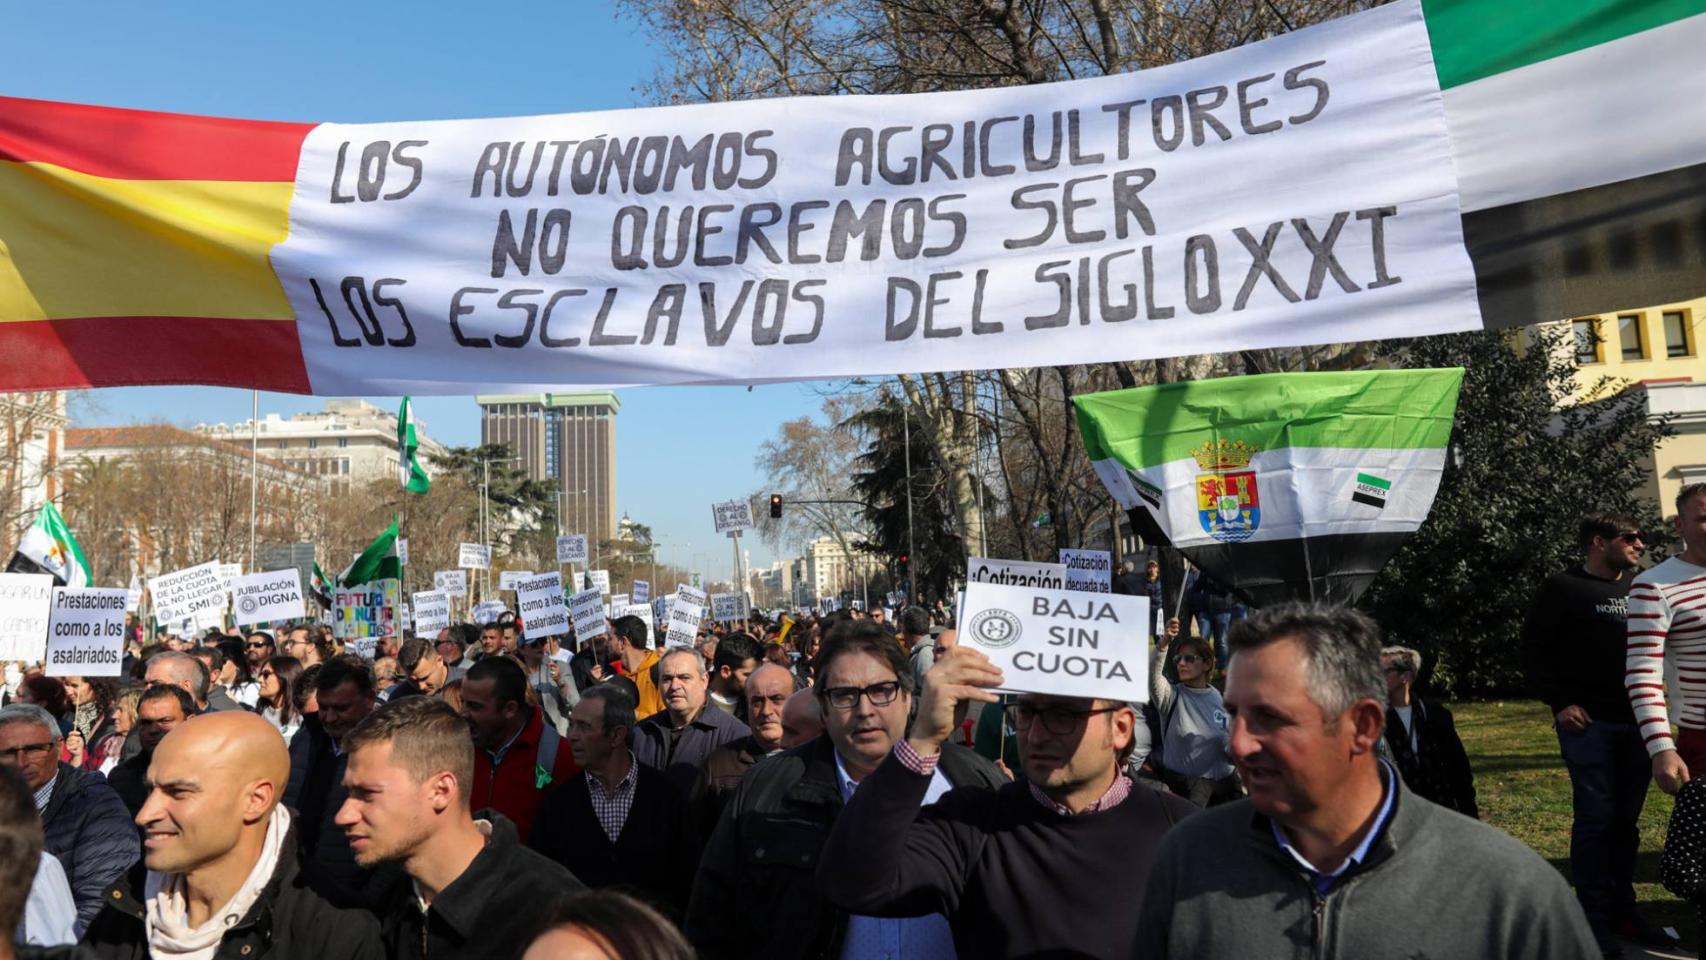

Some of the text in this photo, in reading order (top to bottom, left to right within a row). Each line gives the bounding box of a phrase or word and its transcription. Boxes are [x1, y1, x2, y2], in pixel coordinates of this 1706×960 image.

[330, 60, 1330, 203] LOS AUTÓNOMOS AGRICULTORES
[491, 168, 1157, 278] NO QUEREMOS SER
[309, 276, 416, 347] LOS
[449, 278, 827, 348] ESCLAVOS
[885, 269, 1003, 341] DEL
[1357, 483, 1387, 497] ASEPREX
[158, 567, 212, 588] REDUCCIÓN
[517, 575, 560, 593] Prestaciones
[156, 576, 217, 599] DE LA CUOTA
[157, 584, 222, 608] AL NO LLEGAR
[237, 579, 295, 597] JUBILACIÓN
[1100, 581, 1109, 594] de
[57, 591, 125, 610] Prestaciones
[174, 599, 211, 617] AL SMI
[258, 592, 300, 607] DIGNA
[522, 593, 563, 613] como a los
[1032, 596, 1120, 623] BAJA
[55, 618, 122, 637] como a los
[526, 613, 567, 631] asalariados.
[1048, 626, 1099, 650] SIN
[53, 648, 120, 664] asalariados.
[1012, 651, 1132, 682] CUOTA
